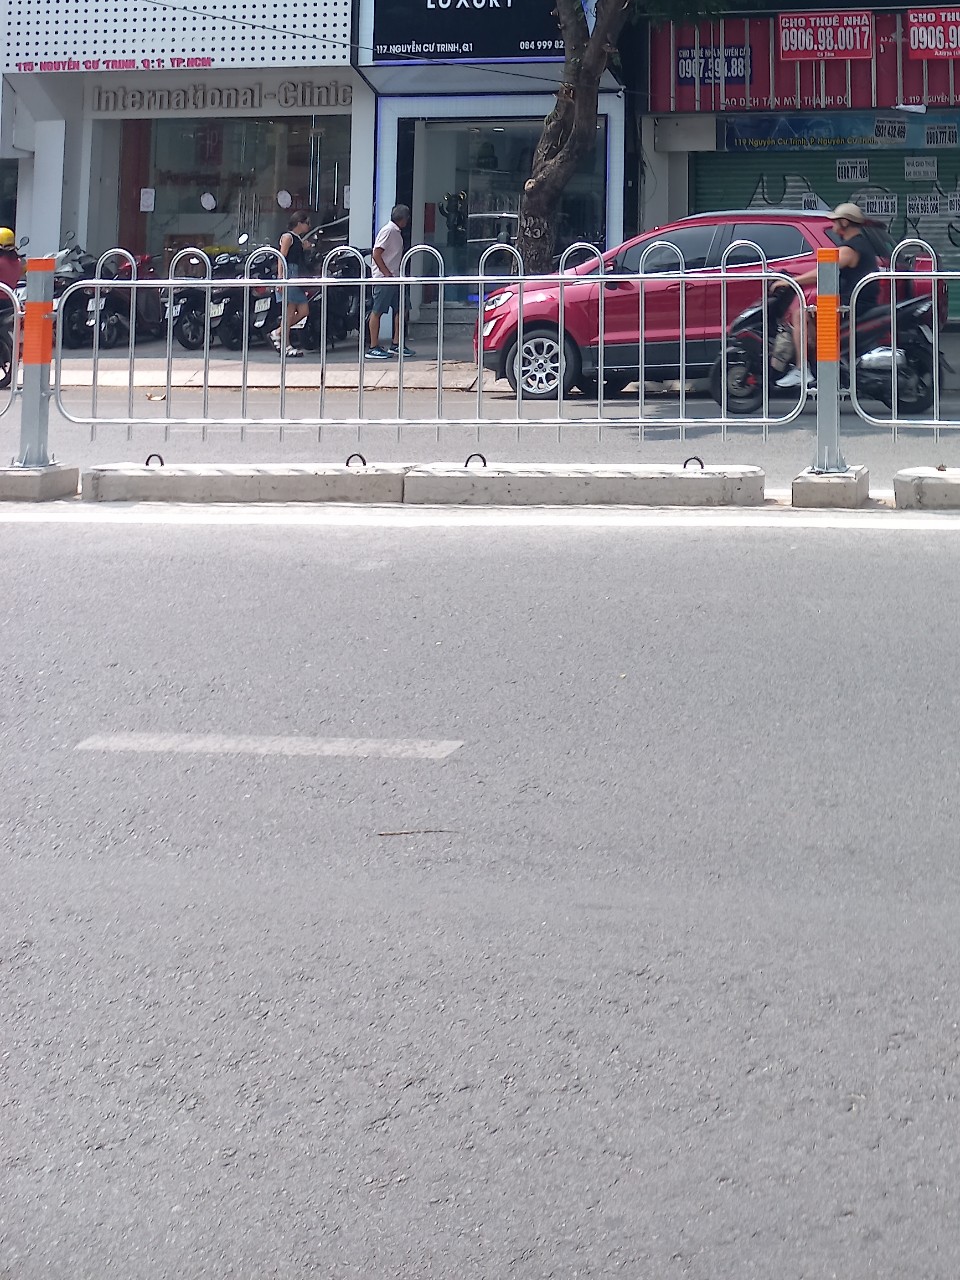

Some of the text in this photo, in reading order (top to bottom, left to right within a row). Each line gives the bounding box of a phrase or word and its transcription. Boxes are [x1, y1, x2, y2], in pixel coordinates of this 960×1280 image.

[781, 13, 870, 28] CHO THUÊ NHÀ
[909, 12, 936, 23] CHO
[536, 40, 553, 50] 999
[781, 27, 870, 52] 0906.98.0017
